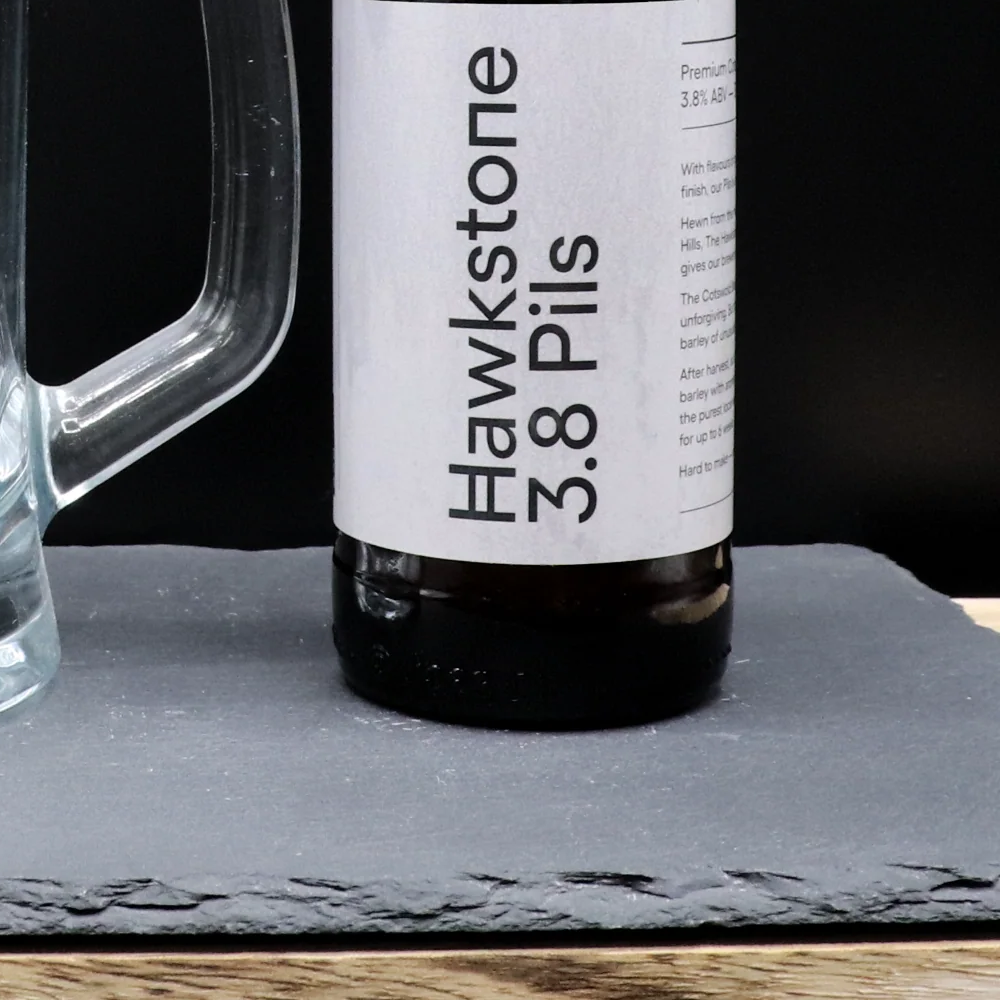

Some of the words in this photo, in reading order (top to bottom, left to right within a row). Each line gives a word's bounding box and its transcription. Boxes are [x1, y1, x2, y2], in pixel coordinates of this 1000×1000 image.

[681, 61, 727, 81] Premium
[681, 89, 708, 108] 3.8%
[710, 85, 728, 104] ABV
[681, 161, 705, 176] With
[681, 215, 708, 230] Hewn
[680, 260, 706, 277] gives
[448, 45, 518, 523] Hawkstone
[528, 233, 600, 371] Pils
[680, 292, 700, 306] The
[680, 335, 709, 350] barley
[680, 367, 704, 381] After
[680, 387, 708, 403] barley
[679, 411, 697, 425] the
[679, 433, 694, 446] for
[696, 431, 708, 445] up
[528, 403, 599, 524] 3.8
[679, 461, 703, 478] Hard
